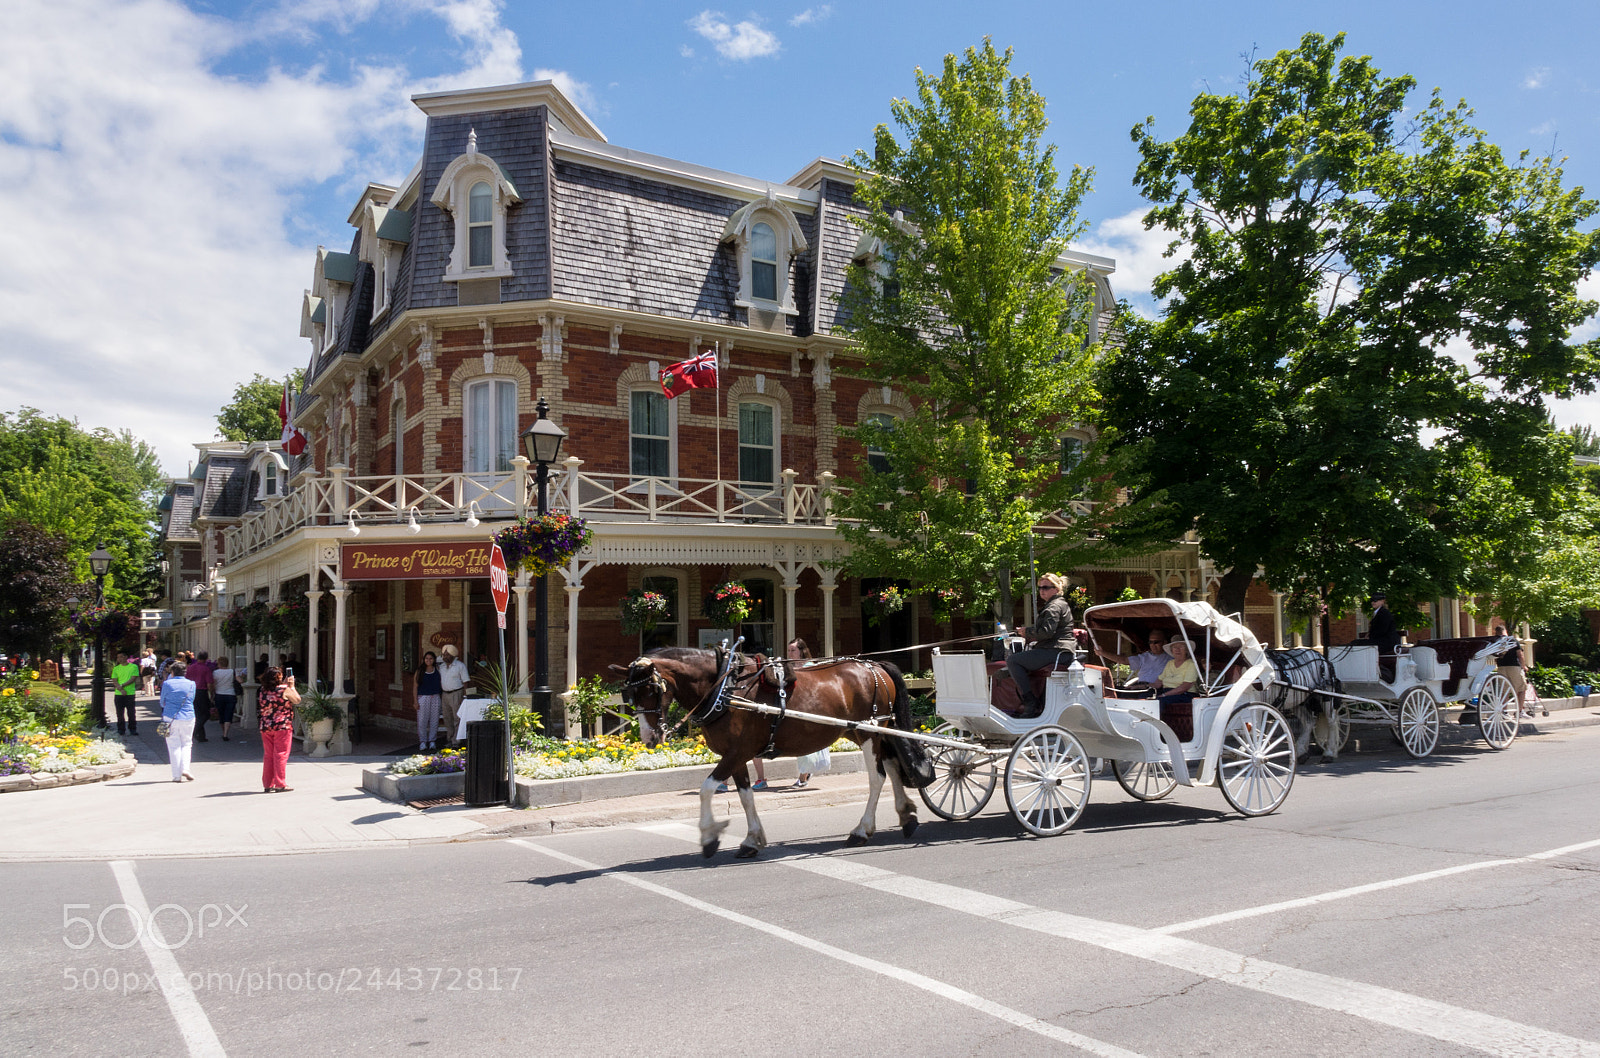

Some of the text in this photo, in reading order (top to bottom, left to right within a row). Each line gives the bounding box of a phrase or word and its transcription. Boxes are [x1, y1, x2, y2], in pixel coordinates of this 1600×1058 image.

[352, 548, 490, 573] Prince of Wales Ho
[491, 565, 507, 594] STOP
